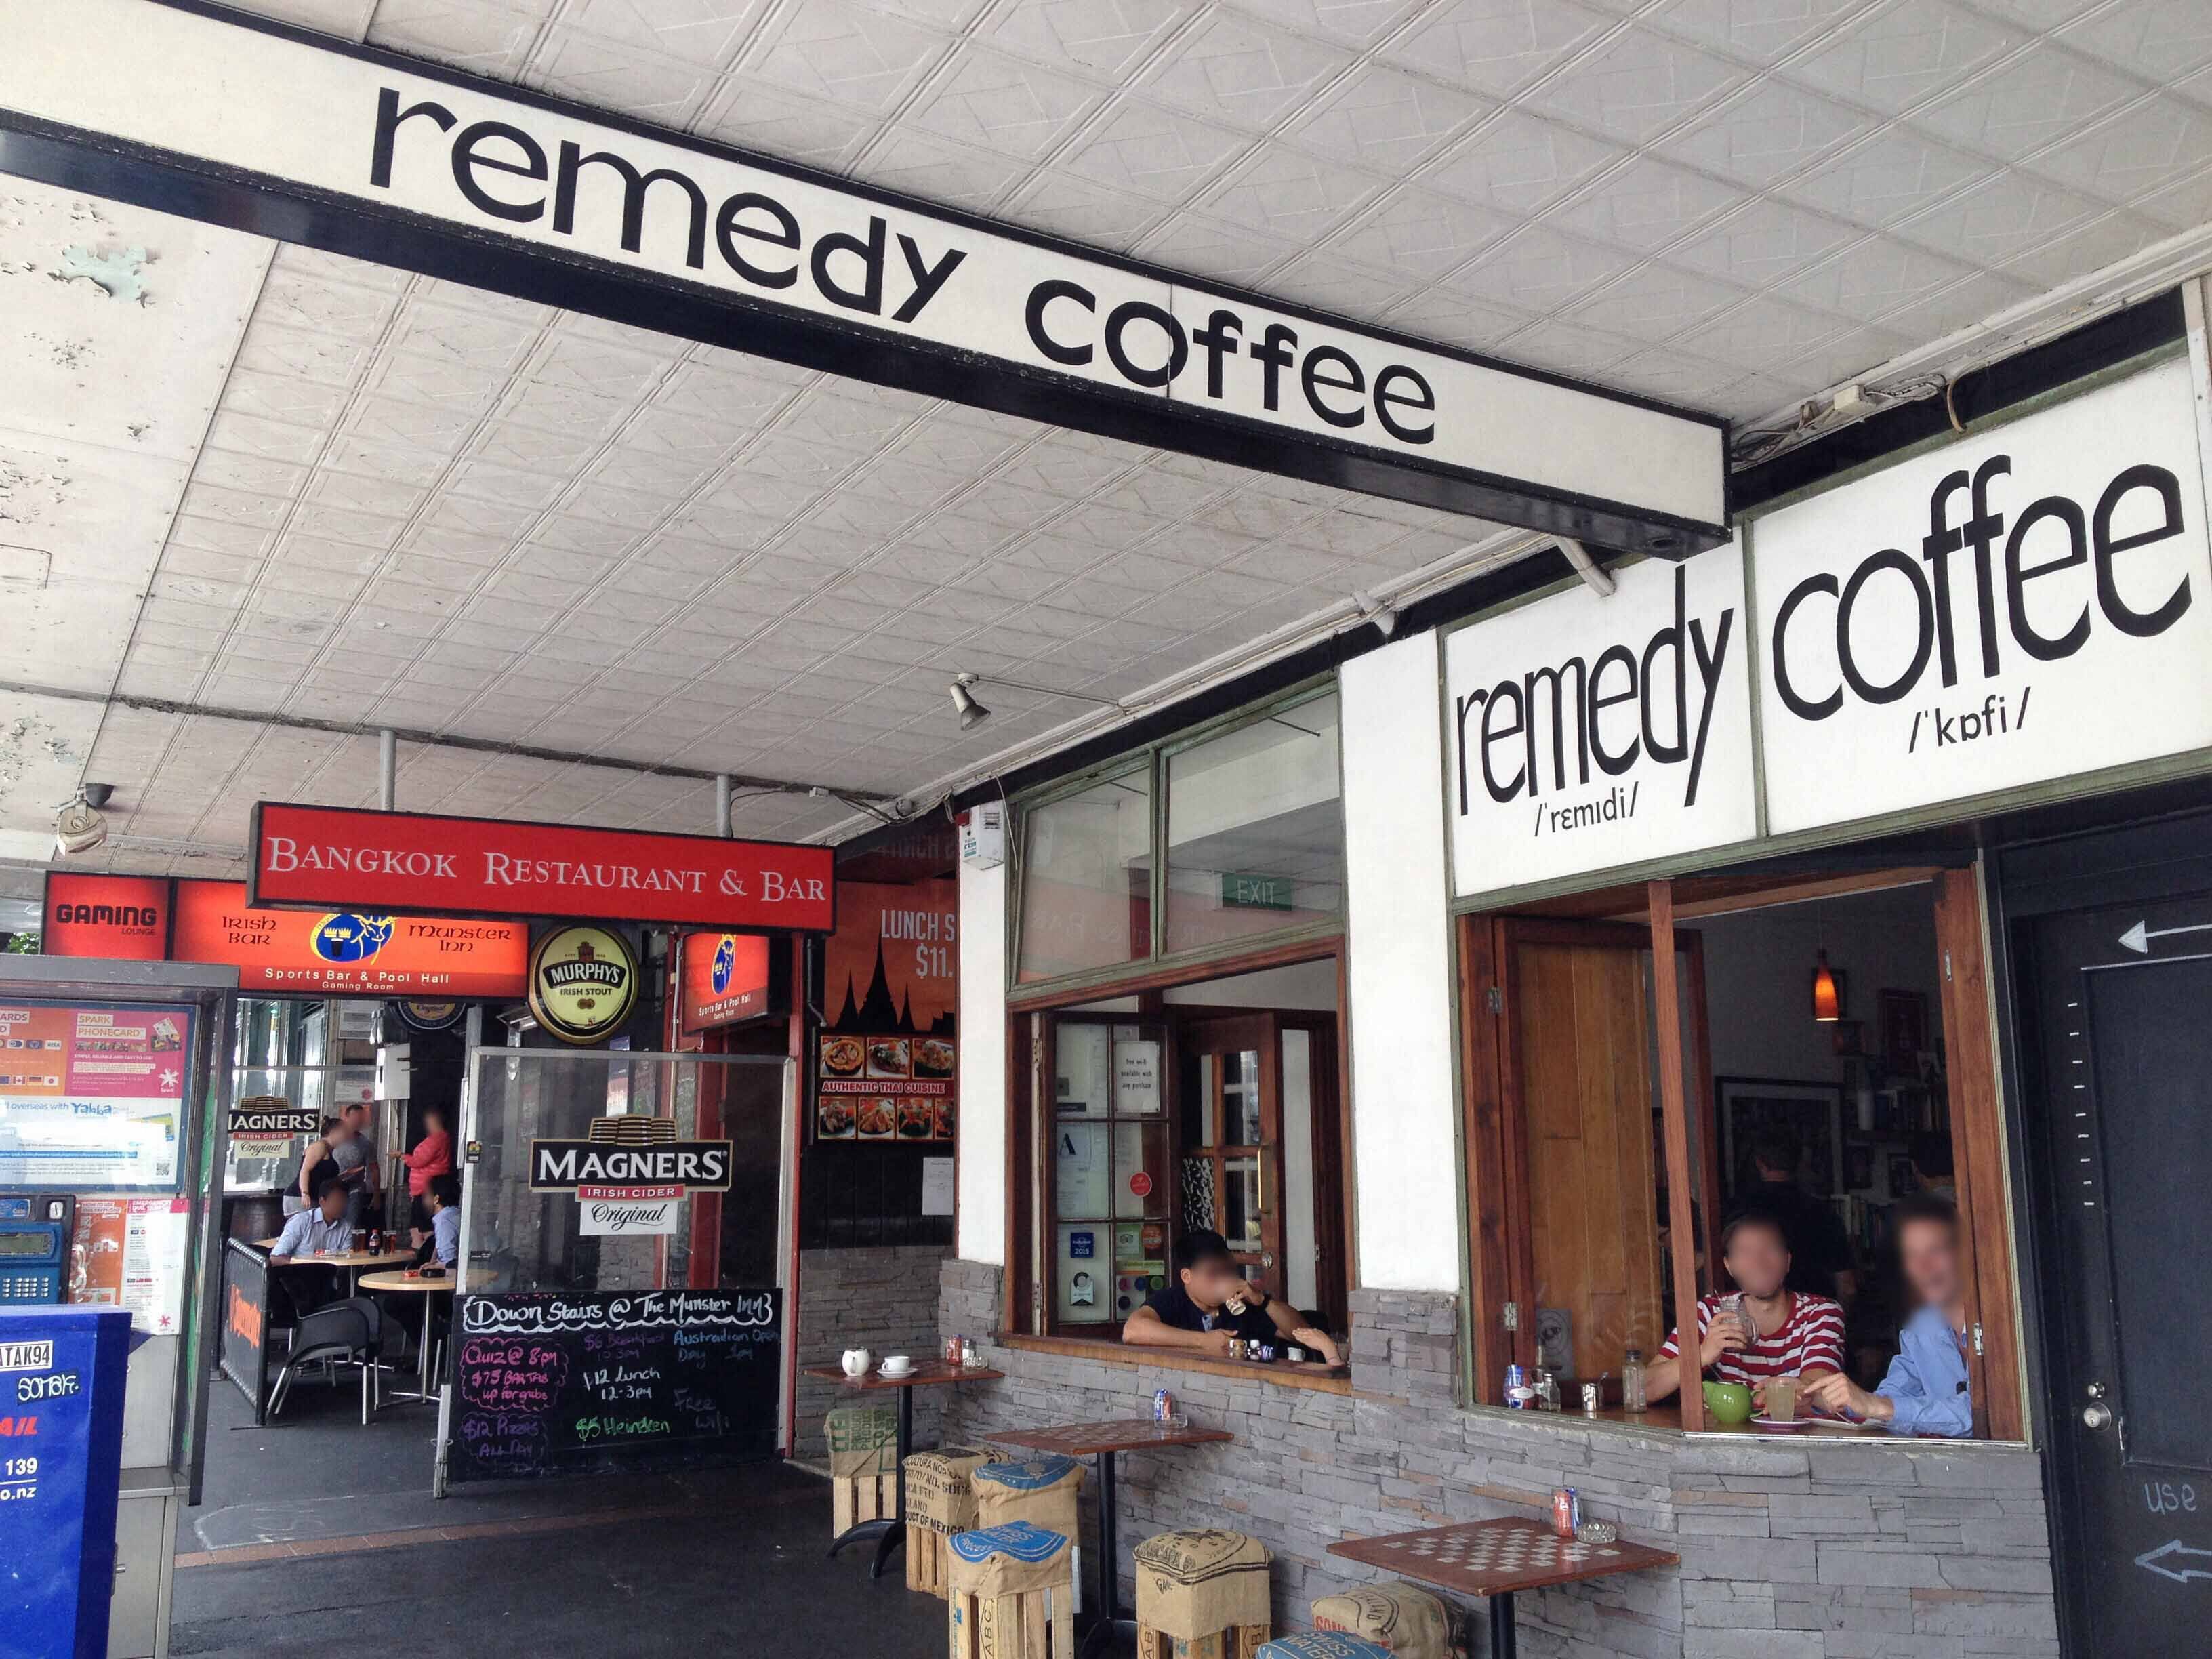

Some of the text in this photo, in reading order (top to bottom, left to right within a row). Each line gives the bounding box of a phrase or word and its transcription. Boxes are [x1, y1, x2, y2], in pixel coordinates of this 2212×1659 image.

[370, 87, 1435, 445] remedy coffee
[1456, 455, 2192, 816] remedy coffee
[267, 837, 826, 903] BANGKOK RESTAURANT & BAR
[1237, 880, 1275, 905] EXIT
[56, 903, 157, 926] GAMING
[121, 928, 156, 936] LOUNGE
[882, 909, 939, 941] LUNCH
[265, 968, 450, 983] Sports Bar & Pool Hall
[322, 981, 394, 991] Gaming Room
[78, 1015, 110, 1023] SPARK
[699, 1005, 714, 1017] Sports
[77, 1027, 141, 1037] PHONECARD
[822, 1081, 946, 1094] AUTHENTIC THAI CUISINE
[11, 1101, 112, 1115] overseas with Yabba
[240, 1141, 284, 1156] Original
[538, 1149, 724, 1181] MAGNERS
[588, 1187, 676, 1197] IRISH CIDER
[590, 1202, 668, 1231] Original
[469, 1297, 543, 1326] Down
[547, 1300, 603, 1323] Stairs
[609, 1298, 631, 1322] @
[634, 1292, 665, 1316] The
[669, 1292, 731, 1324] Munster
[5, 1457, 38, 1476] 139
[930, 1518, 965, 1536] MEXICO
